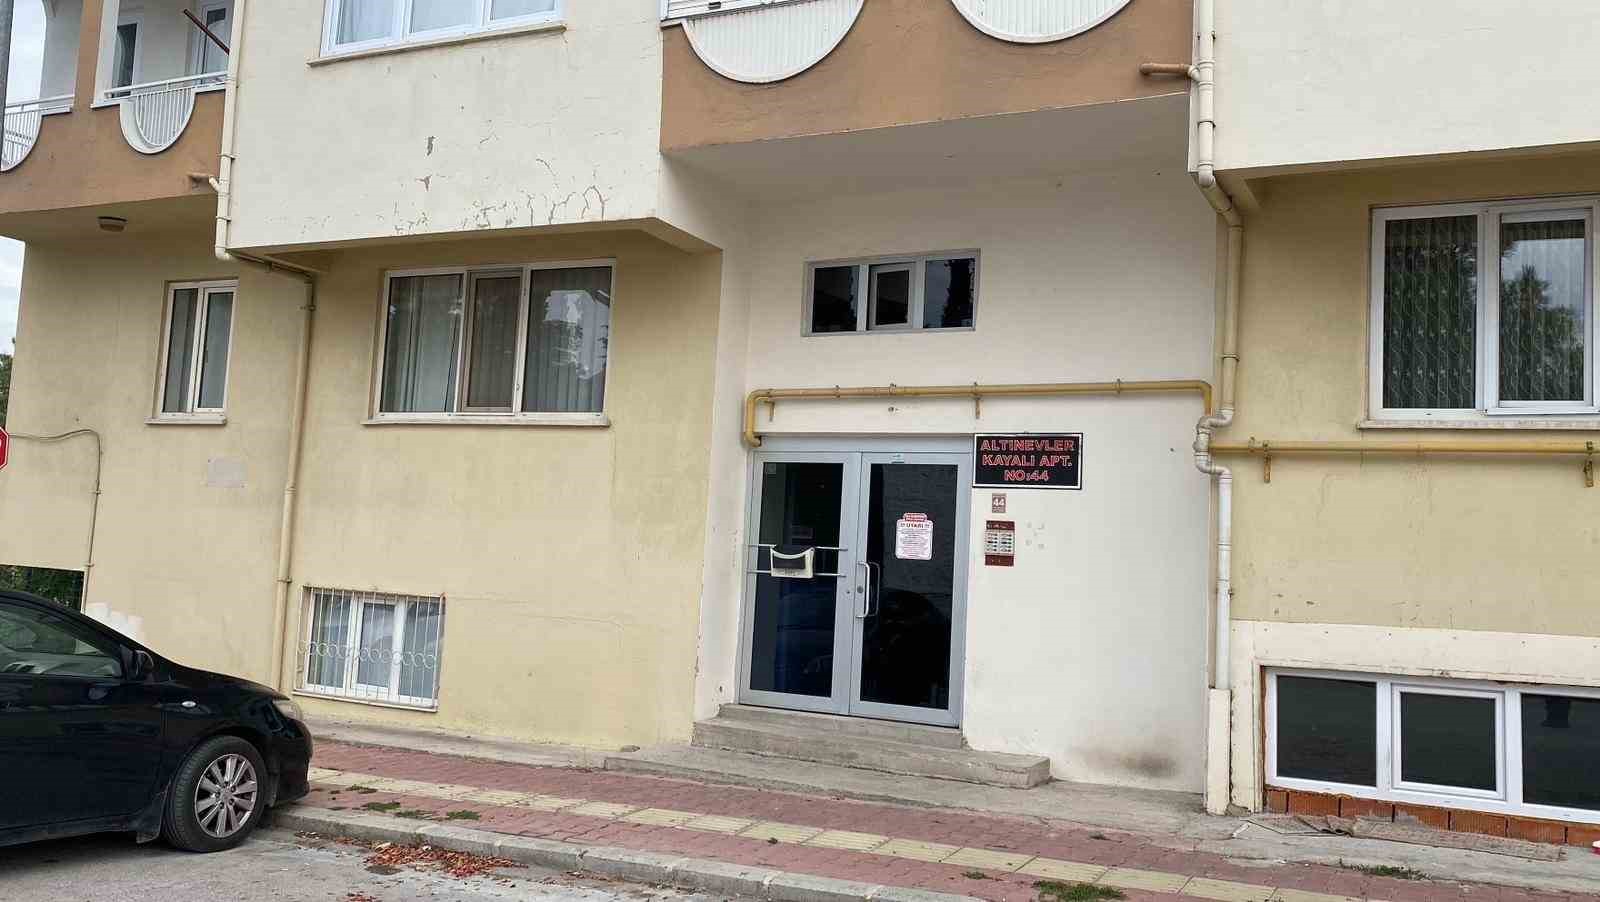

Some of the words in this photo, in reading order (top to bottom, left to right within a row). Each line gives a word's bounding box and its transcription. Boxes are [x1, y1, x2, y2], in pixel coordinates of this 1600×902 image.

[981, 439, 1075, 451] ALTINEVLER
[982, 454, 1035, 466] KAYALI
[1040, 455, 1073, 467] APT.
[1004, 469, 1049, 482] NO:44
